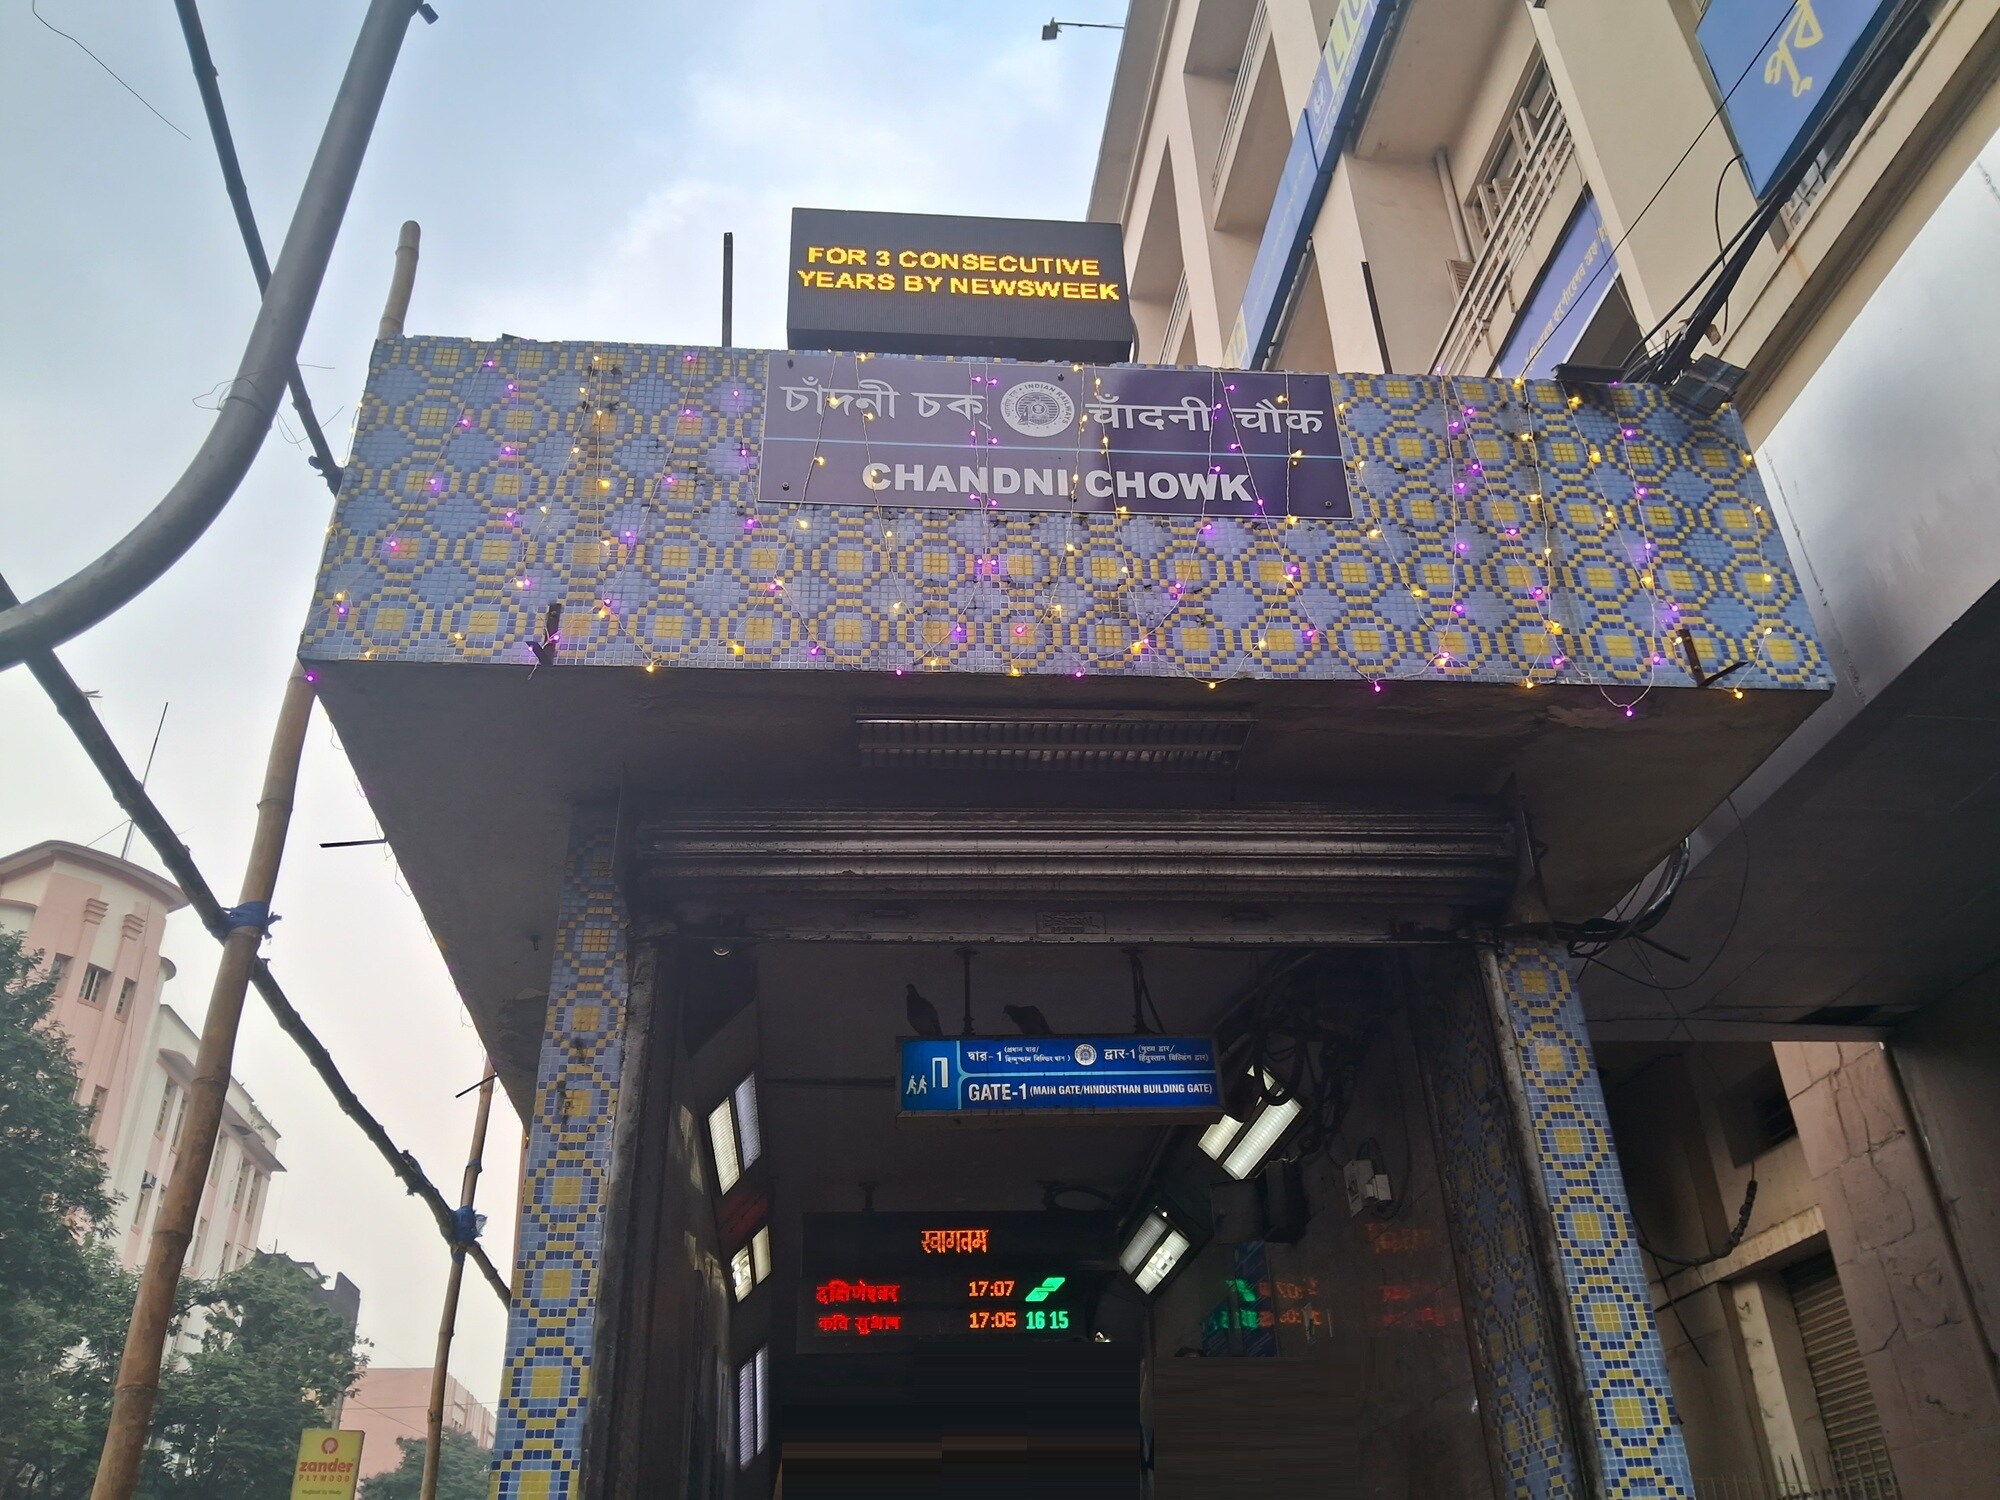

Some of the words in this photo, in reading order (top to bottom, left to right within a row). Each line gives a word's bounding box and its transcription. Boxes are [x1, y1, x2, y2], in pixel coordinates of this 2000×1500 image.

[808, 246, 867, 267] FOR
[875, 250, 890, 267] 3
[898, 250, 1100, 277] CONSECUTIVE
[798, 270, 896, 291] YEARS
[903, 274, 943, 294] BY
[949, 278, 1120, 301] NEWSWEEK
[779, 375, 901, 418] চাঁদনী
[1024, 383, 1056, 393] INDIAN
[1056, 391, 1073, 425] RAILWAYS
[1231, 399, 1324, 434] चौक
[862, 462, 1068, 496] CHANDNI
[1085, 471, 1254, 502] CHOWK
[1104, 1048, 1136, 1061] द्वार-1
[968, 1083, 1027, 1101] GATE-1
[1030, 1085, 1056, 1097] (MAIN
[1059, 1084, 1141, 1095] GATE/HINDUSTHAN
[1143, 1083, 1185, 1094] BUILDING
[1187, 1083, 1213, 1094] GATE)
[968, 1280, 1016, 1298] 17:07
[818, 1313, 851, 1332] कवि
[968, 1311, 1017, 1329] 17:05
[299, 1457, 354, 1473] zander
[298, 1474, 350, 1483] PLYWOOD
